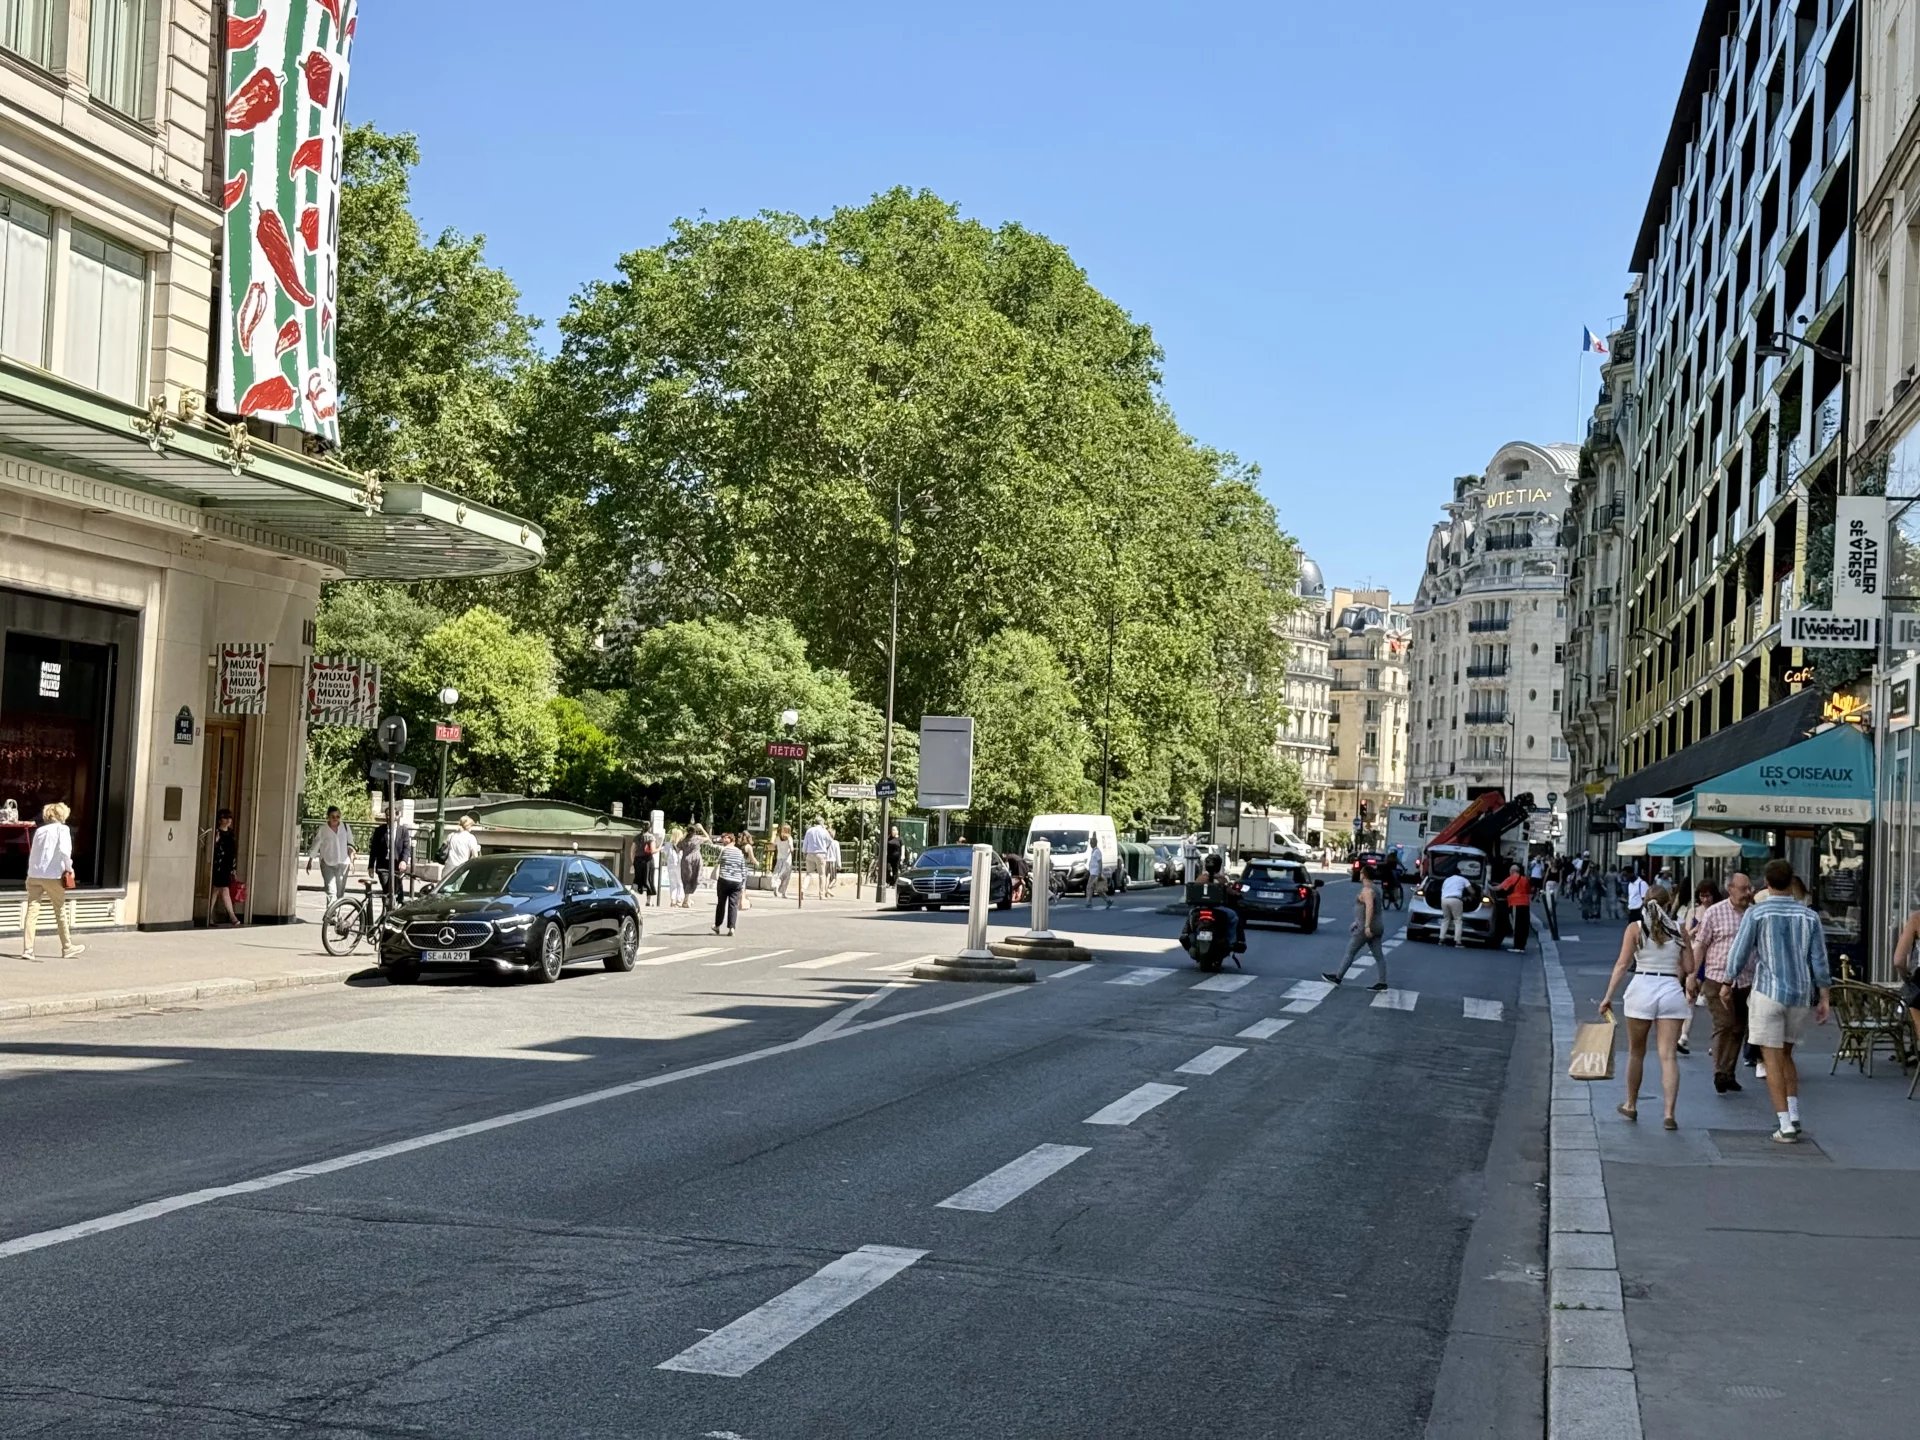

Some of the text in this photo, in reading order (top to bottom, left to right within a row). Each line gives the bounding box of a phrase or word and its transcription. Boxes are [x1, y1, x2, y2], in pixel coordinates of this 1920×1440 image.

[1862, 538, 1878, 594] ATELIER
[1804, 623, 1854, 635] Wolford
[230, 660, 257, 669] MUXU
[230, 669, 257, 677] bisous
[318, 672, 351, 681] MUXU
[229, 678, 256, 686] MUXU
[318, 681, 350, 689] bisous
[228, 686, 256, 694] bisous
[317, 689, 350, 698] MUXU
[317, 697, 349, 705] bisous
[770, 745, 804, 757] METRO
[1760, 766, 1853, 781] LES OISEAUX
[1759, 804, 1854, 816] 45 RUE DE SÈVRES
[167, 827, 173, 841] 6
